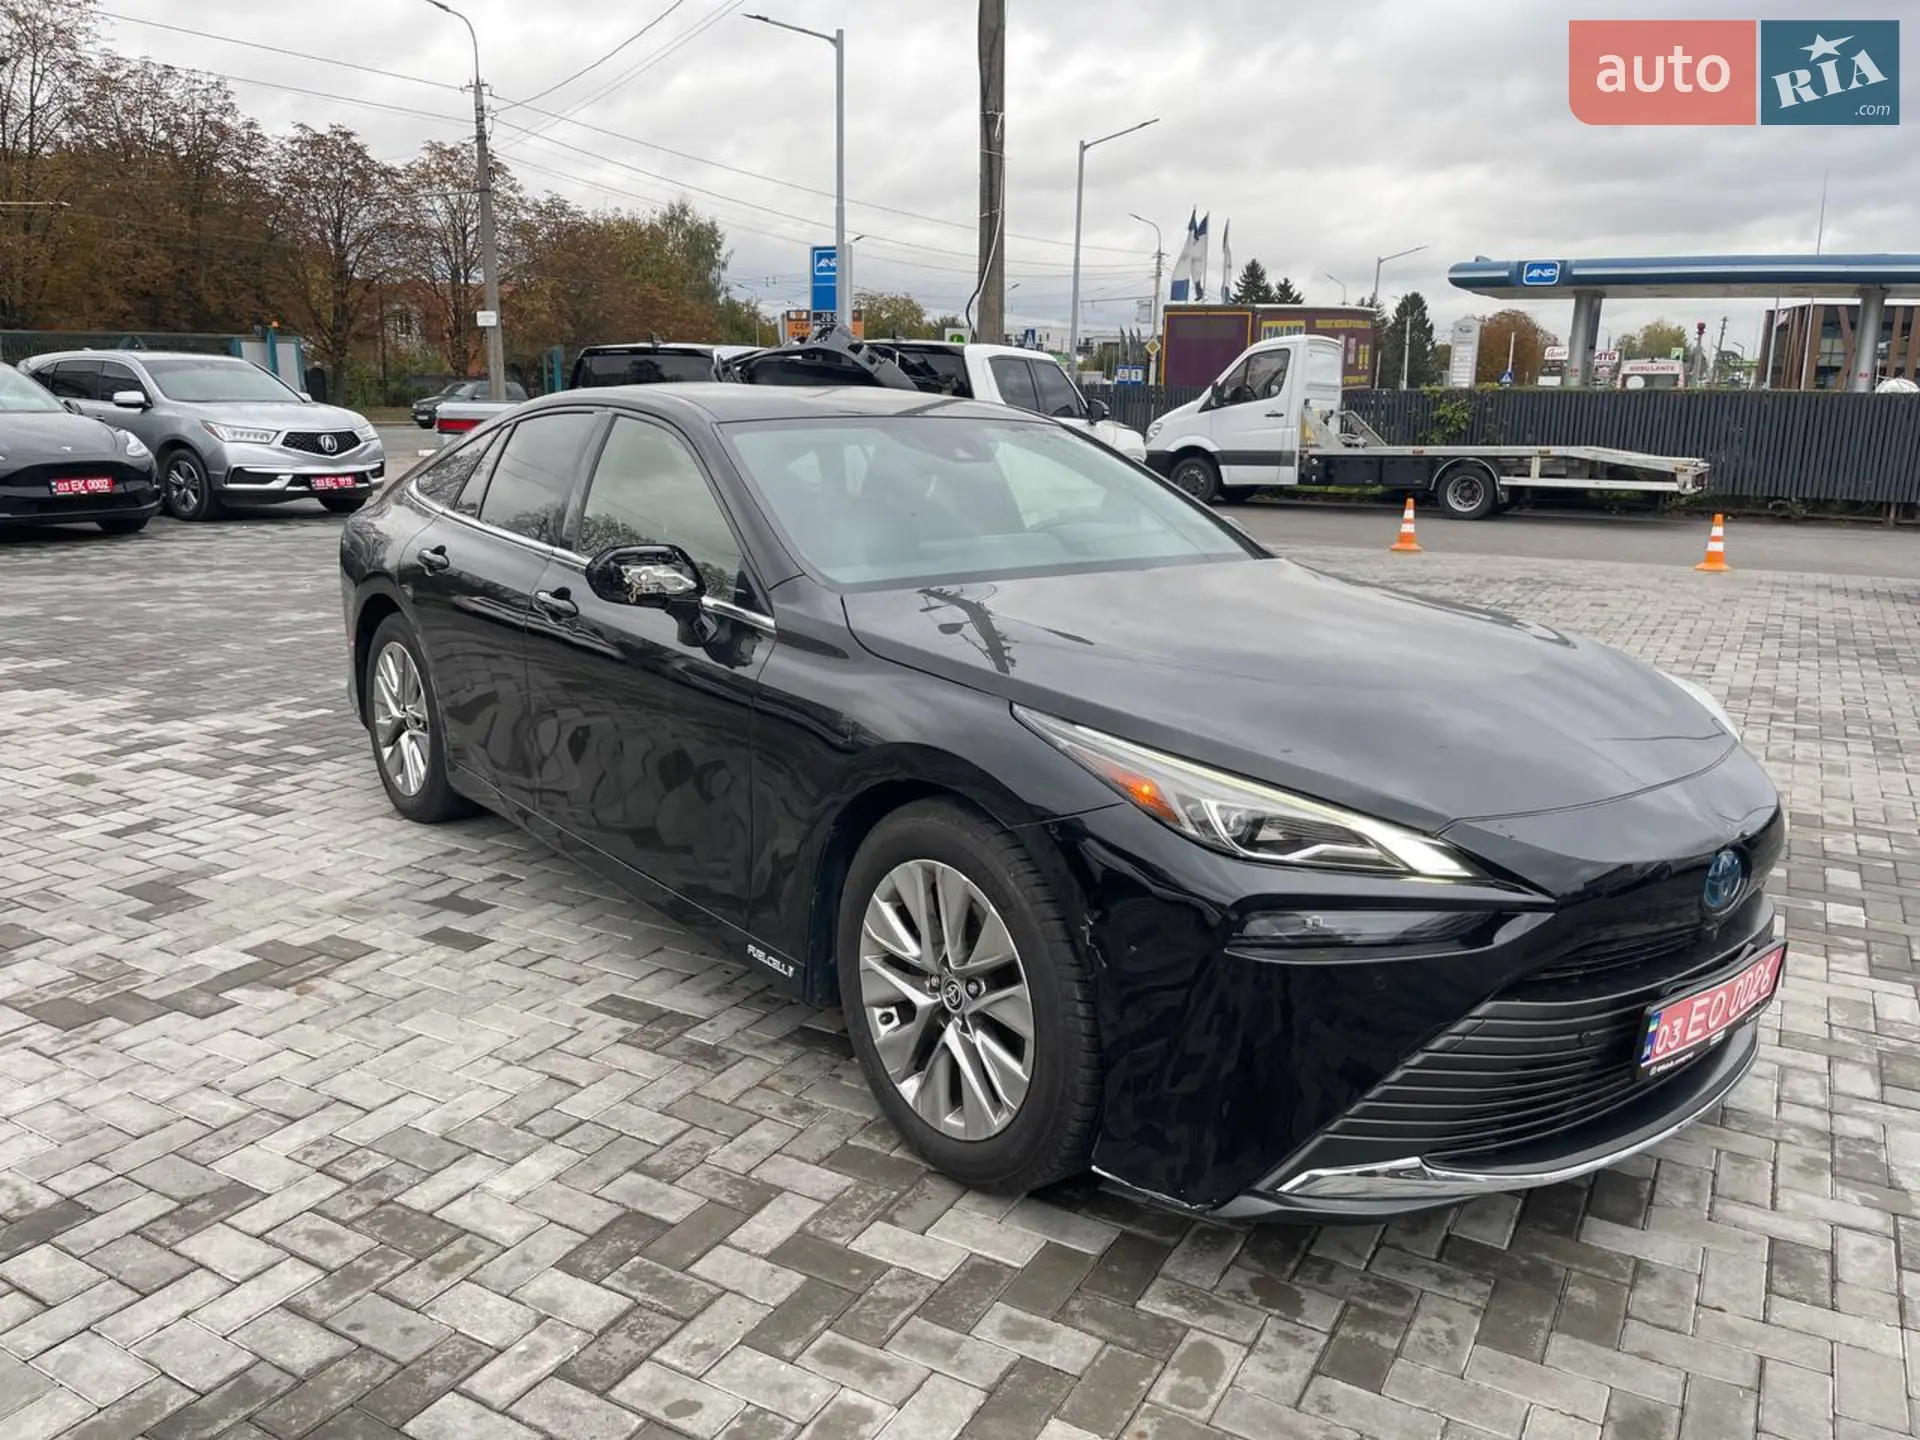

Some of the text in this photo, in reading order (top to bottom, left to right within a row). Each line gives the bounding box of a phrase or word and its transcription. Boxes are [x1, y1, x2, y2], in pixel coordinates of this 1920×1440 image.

[1629, 364, 1675, 372] AMBULANCE
[58, 478, 109, 491] 03 EK 0002
[1656, 1017, 1684, 1054] 03
[1686, 991, 1727, 1041] EO
[1729, 956, 1777, 1018] 0026
